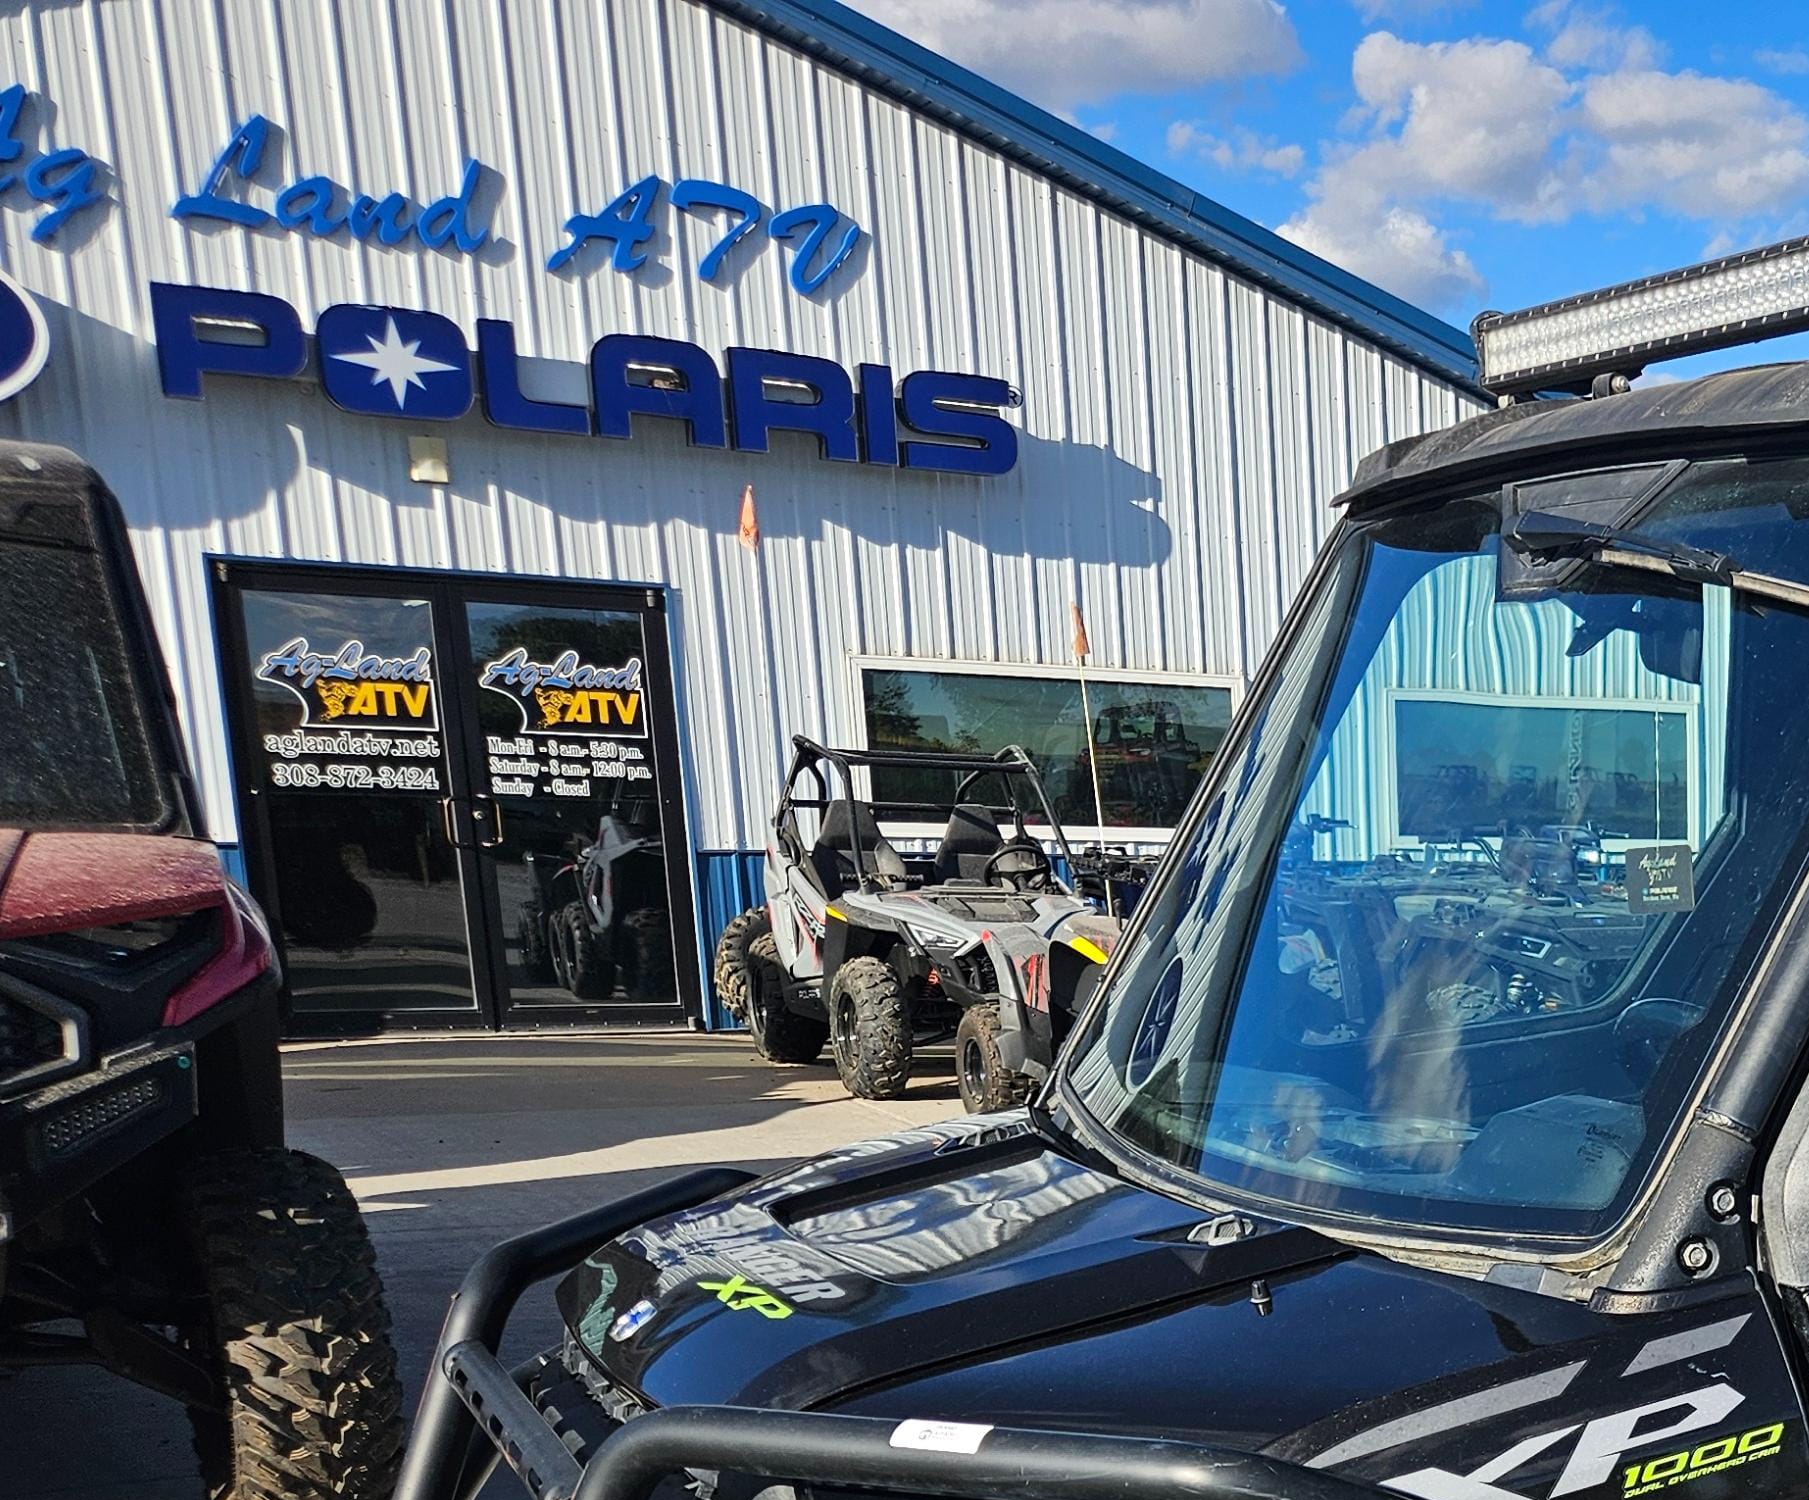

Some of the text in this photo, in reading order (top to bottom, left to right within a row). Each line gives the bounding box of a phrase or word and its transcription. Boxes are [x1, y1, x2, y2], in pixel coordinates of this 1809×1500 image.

[171, 113, 488, 255] Land
[545, 174, 861, 296] ATV
[150, 281, 1018, 475] POLARIS
[350, 682, 429, 718] ATV
[565, 690, 640, 725] ATV
[264, 729, 441, 758] aglandatv.net
[487, 736, 535, 756] Mon-Fri
[548, 740, 559, 757] 8
[590, 741, 617, 759] 5:30
[619, 746, 644, 761] p.m.
[271, 763, 440, 790] 308-872-3424
[489, 756, 540, 777] Saturday
[549, 760, 560, 776] 8
[592, 761, 626, 778] 12:00
[627, 766, 652, 781] p.m.
[492, 776, 534, 797] Sunday
[552, 778, 591, 797] Closed
[696, 1273, 794, 1320] XP
[1623, 1421, 1785, 1489] 1000
[1624, 1445, 1782, 1499] DUAL OVERHEAD CAM
